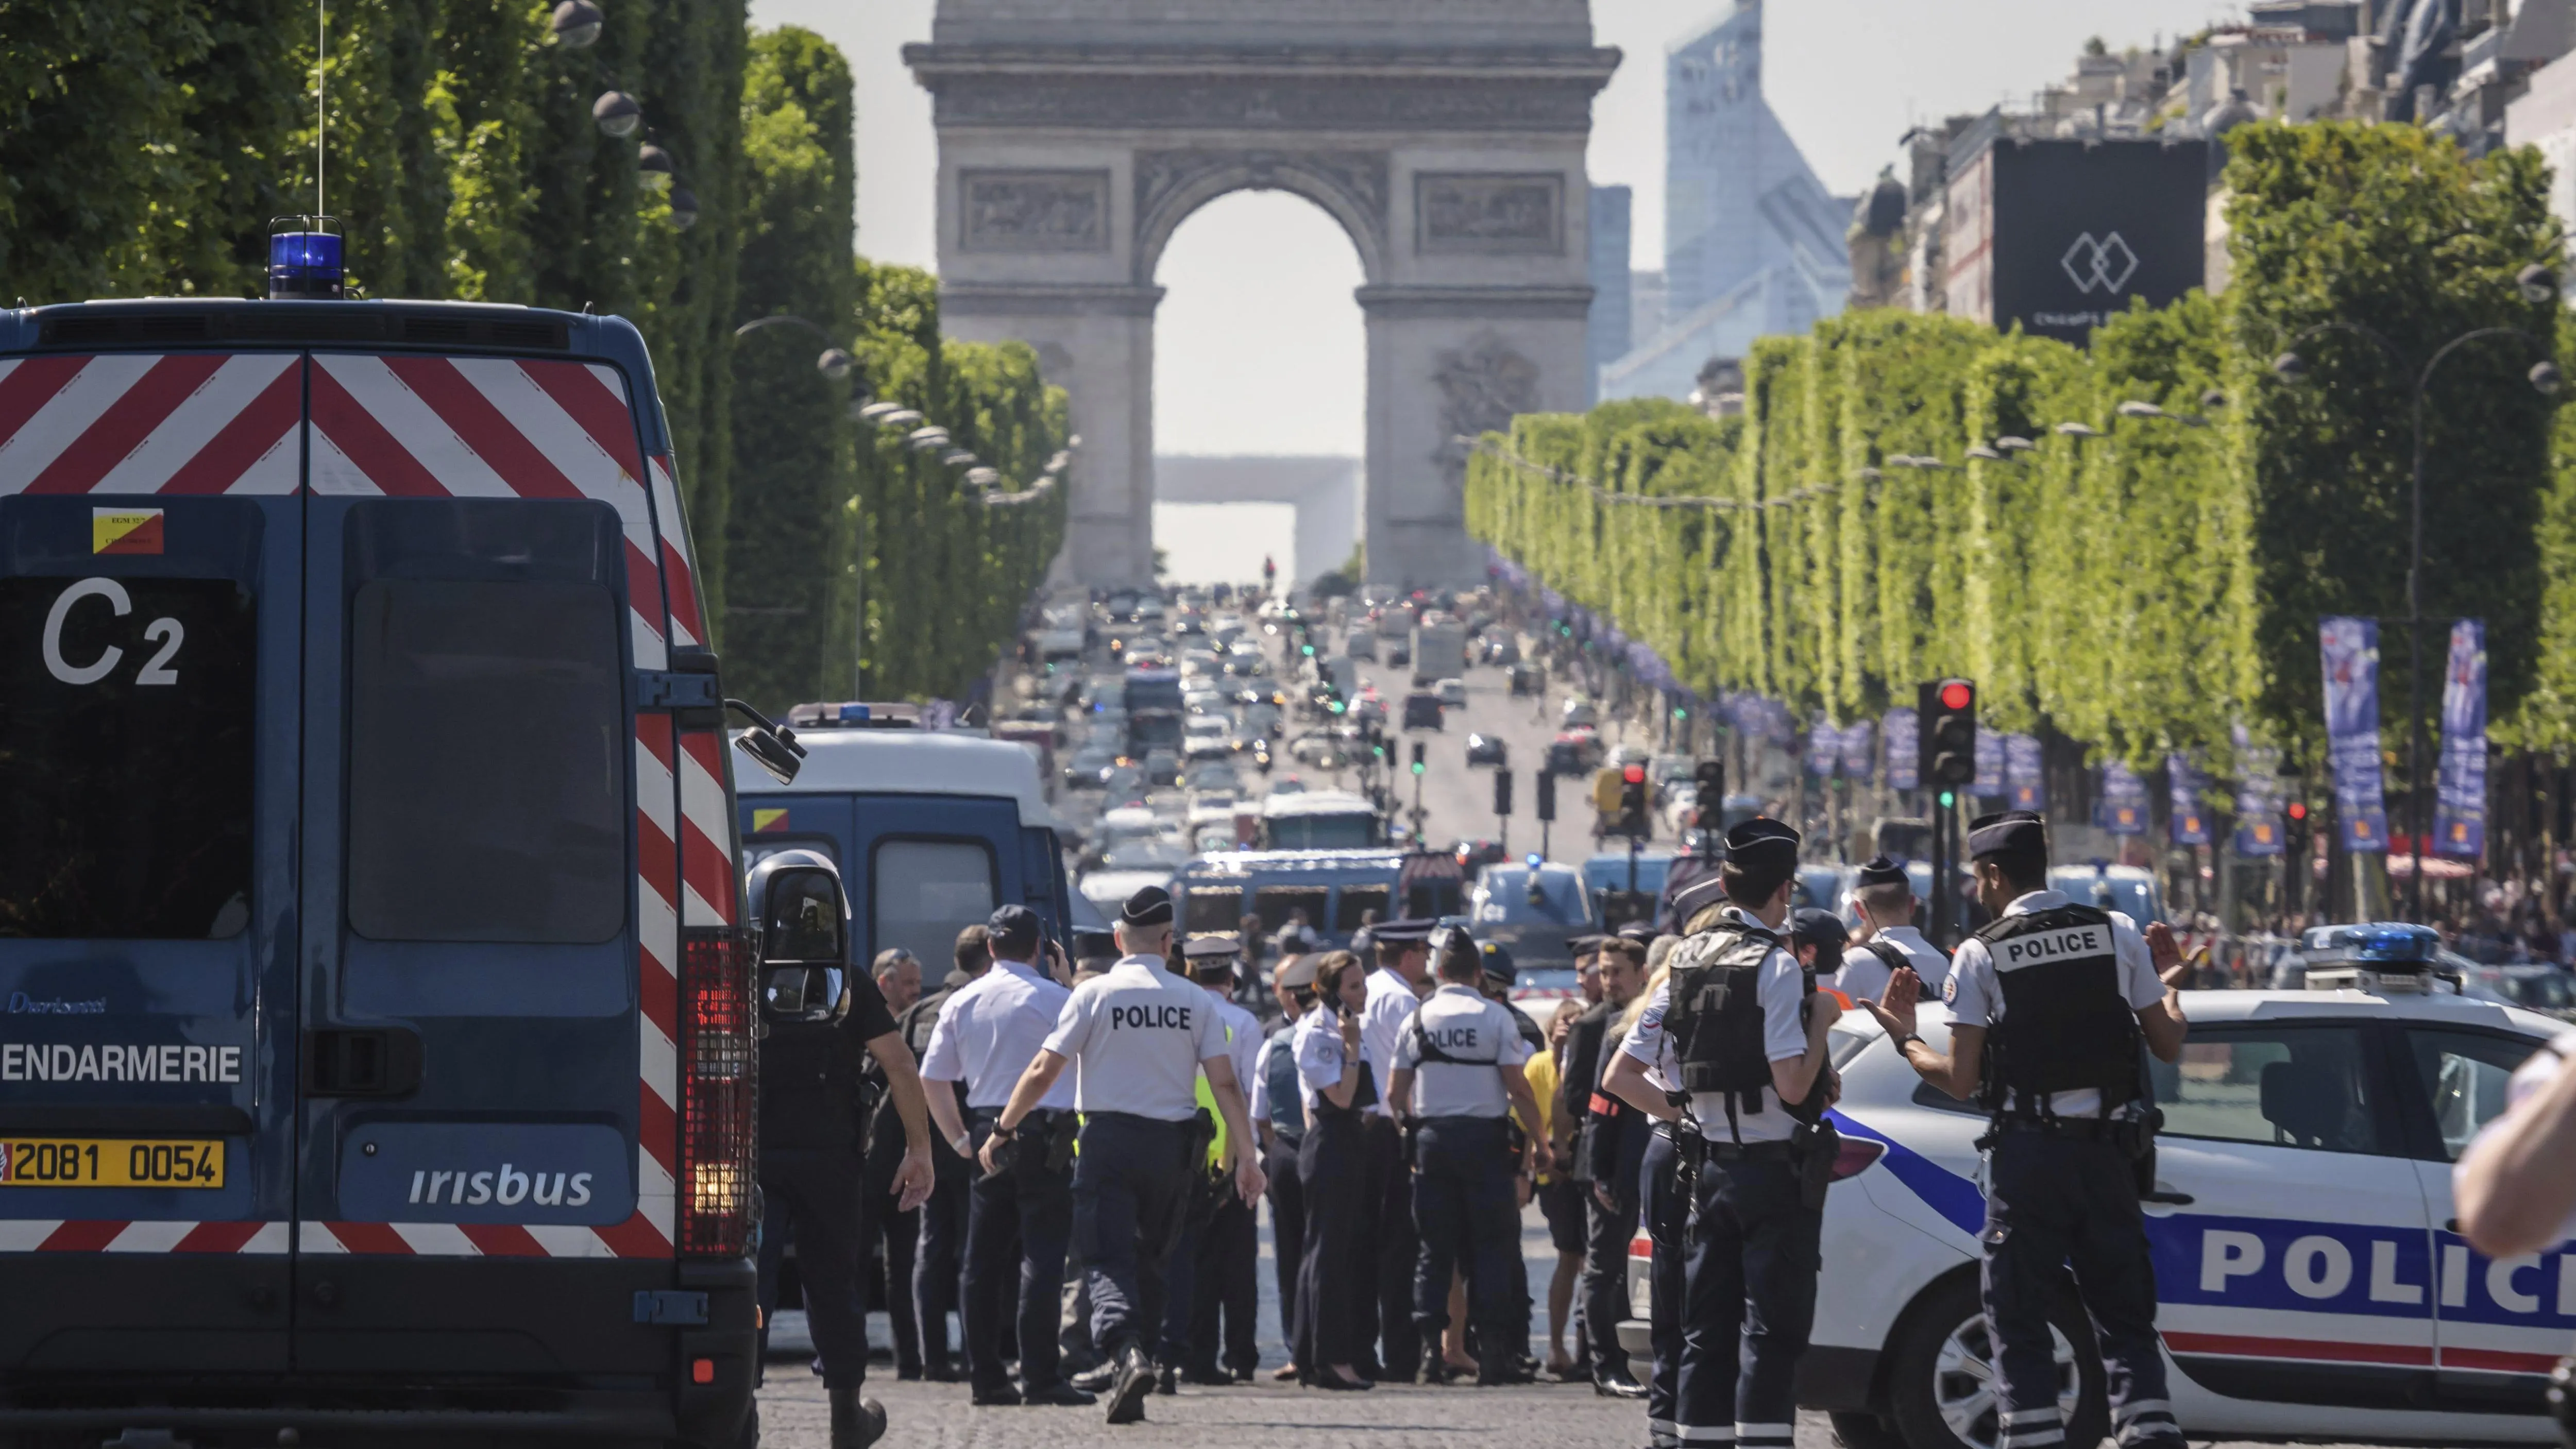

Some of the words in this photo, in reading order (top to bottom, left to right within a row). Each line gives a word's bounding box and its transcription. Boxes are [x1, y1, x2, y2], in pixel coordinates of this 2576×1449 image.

[2008, 931, 2098, 962] POLICE
[1112, 1005, 1191, 1030] POLICE
[1427, 1028, 1477, 1047] OLICE
[2, 1044, 241, 1082] ENDARMERIE
[14, 1143, 98, 1180] 2081
[129, 1145, 215, 1181] 0054
[409, 1163, 592, 1206] irisbus
